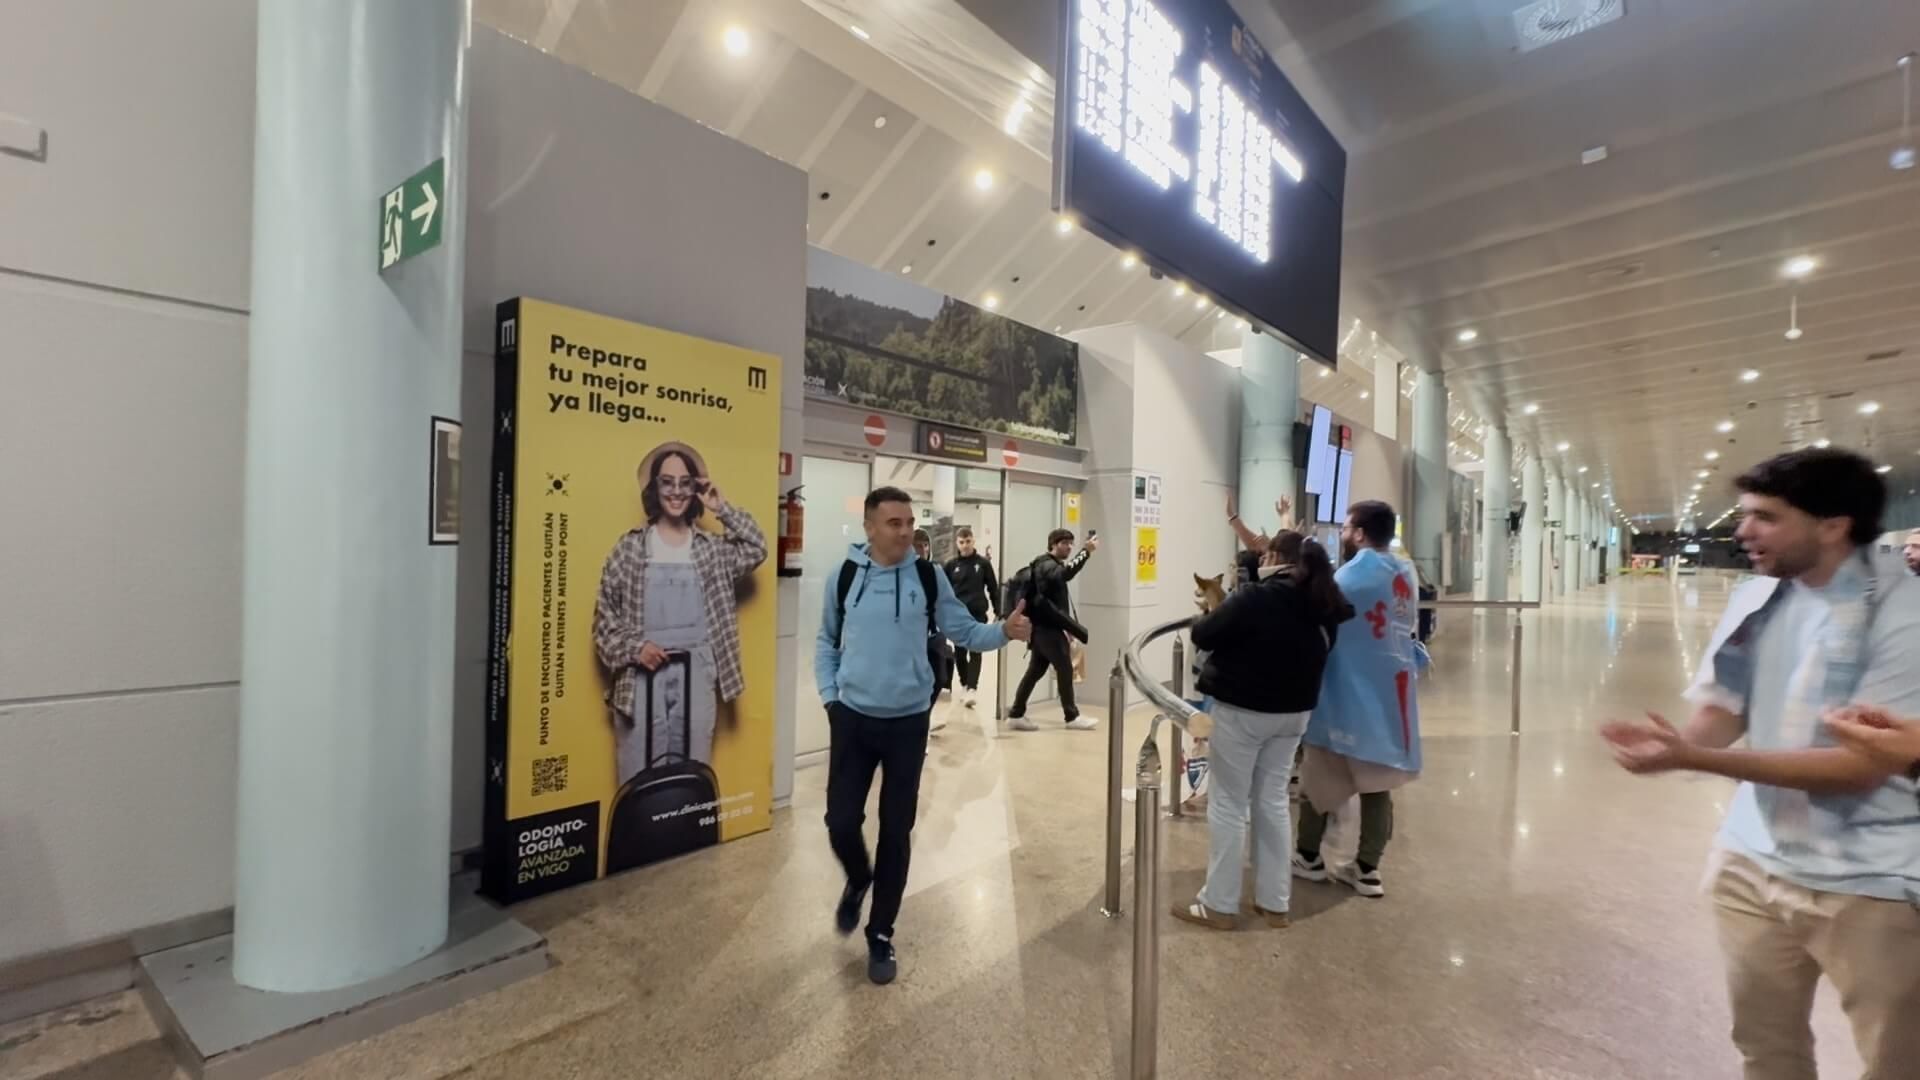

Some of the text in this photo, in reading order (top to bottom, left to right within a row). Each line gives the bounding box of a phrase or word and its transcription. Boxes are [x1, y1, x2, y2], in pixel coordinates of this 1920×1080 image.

[550, 334, 647, 371] Prepara
[549, 363, 733, 413] tu mejor sonrisa,
[548, 392, 667, 423] ya llega...
[559, 512, 568, 546] POINT
[558, 550, 568, 597] MEETING
[539, 512, 554, 745] PUNTO DE ENCUENTRO PACIENTES GUITIÁN
[557, 600, 567, 649] PATIENTS
[518, 835, 564, 858] LOGÍA
[519, 819, 588, 844] ODONTO-
[518, 861, 570, 884] EN VIGO
[519, 845, 585, 871] AVANZADA
